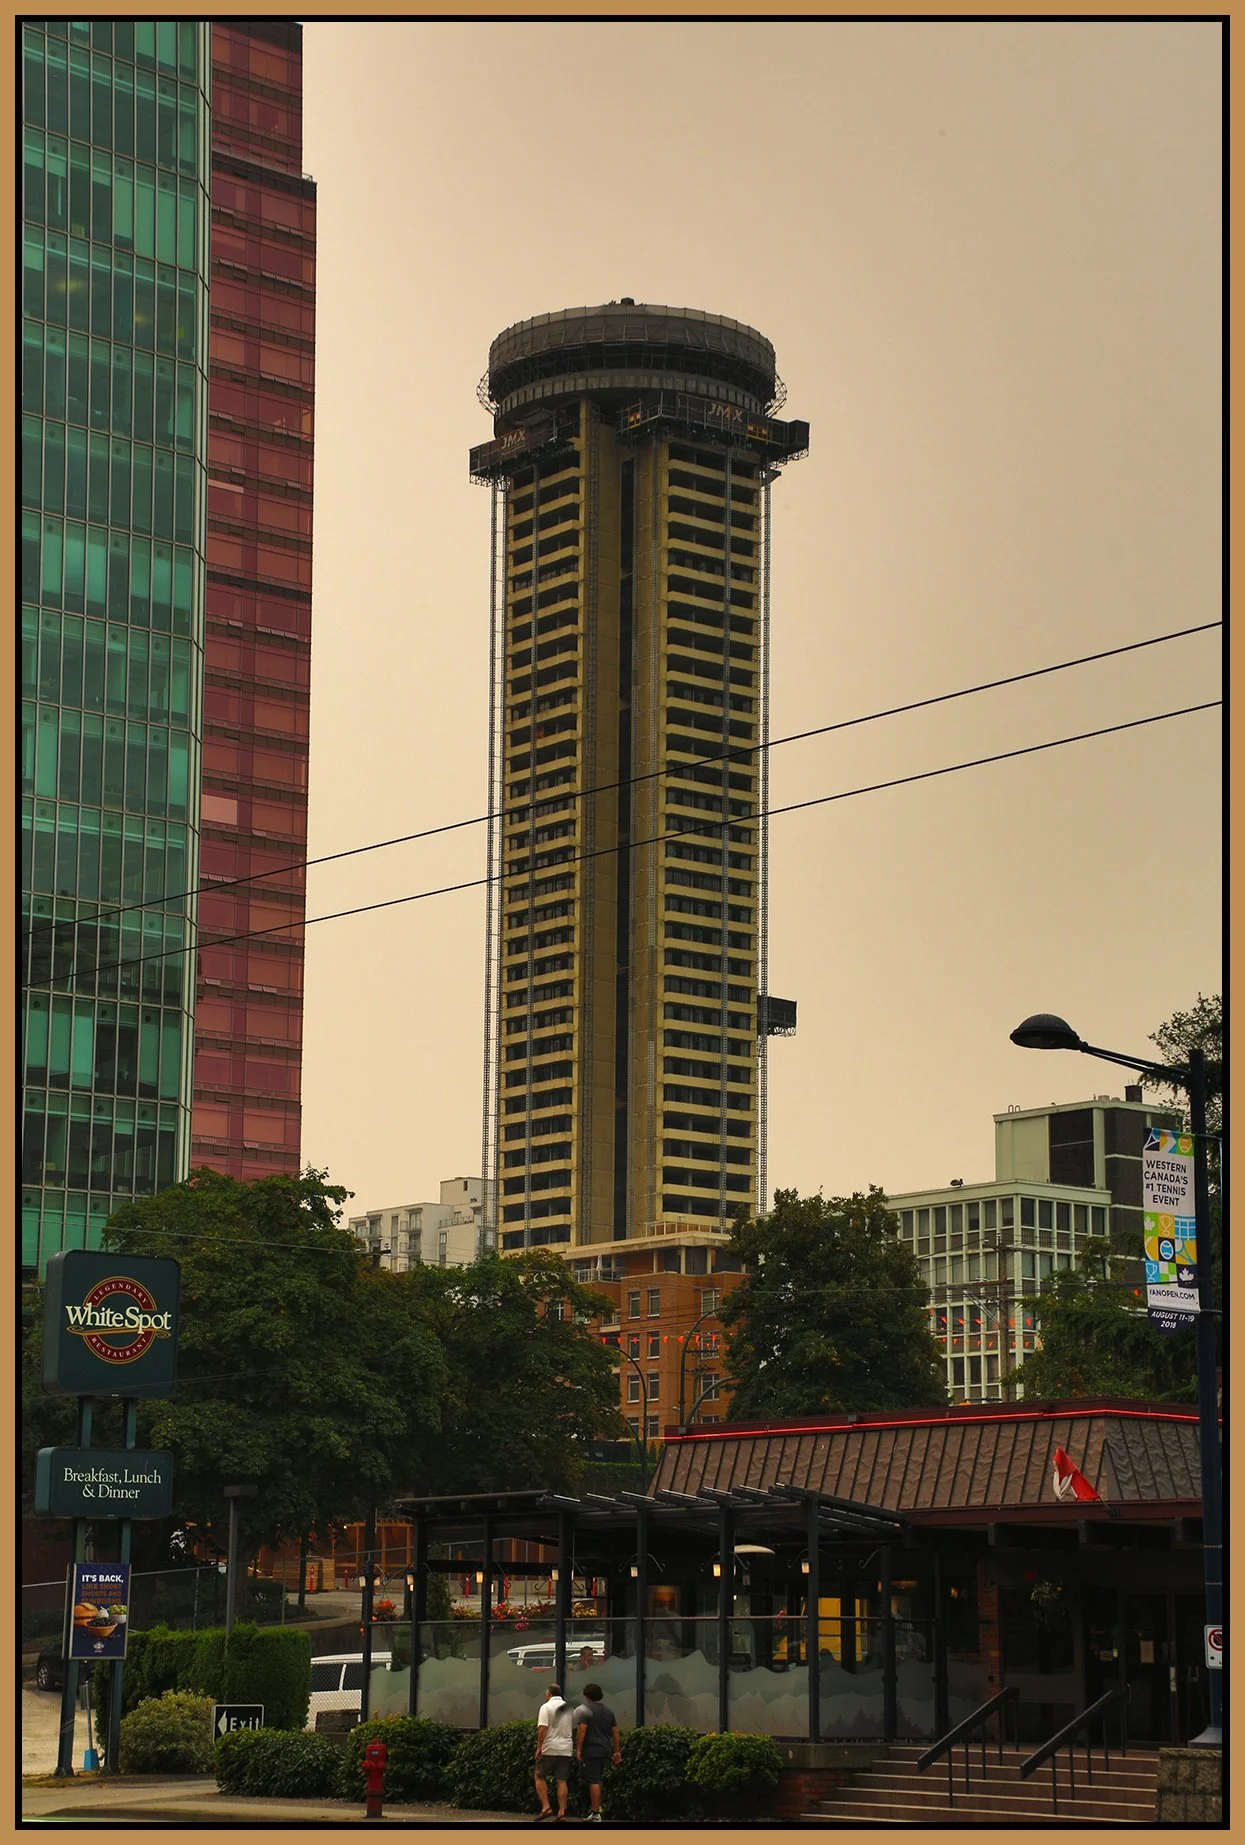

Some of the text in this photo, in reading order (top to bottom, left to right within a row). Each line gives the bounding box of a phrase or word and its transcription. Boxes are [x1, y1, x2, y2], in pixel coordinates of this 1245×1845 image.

[1146, 1160, 1187, 1173] WESTERN
[1144, 1171, 1188, 1185] CANADA'S
[1145, 1183, 1186, 1196] #1 TENNIS
[1152, 1195, 1179, 1206] EVENT
[94, 1283, 148, 1304] LEGENDARY
[1151, 1311, 1178, 1320] AUGUST
[1160, 1320, 1177, 1329] 2018
[91, 1337, 148, 1358] RESTAURANT
[63, 1467, 162, 1485] Breakfast, Lunch
[82, 1484, 141, 1499] & Dinner
[82, 1574, 124, 1584] IT'S BACK,
